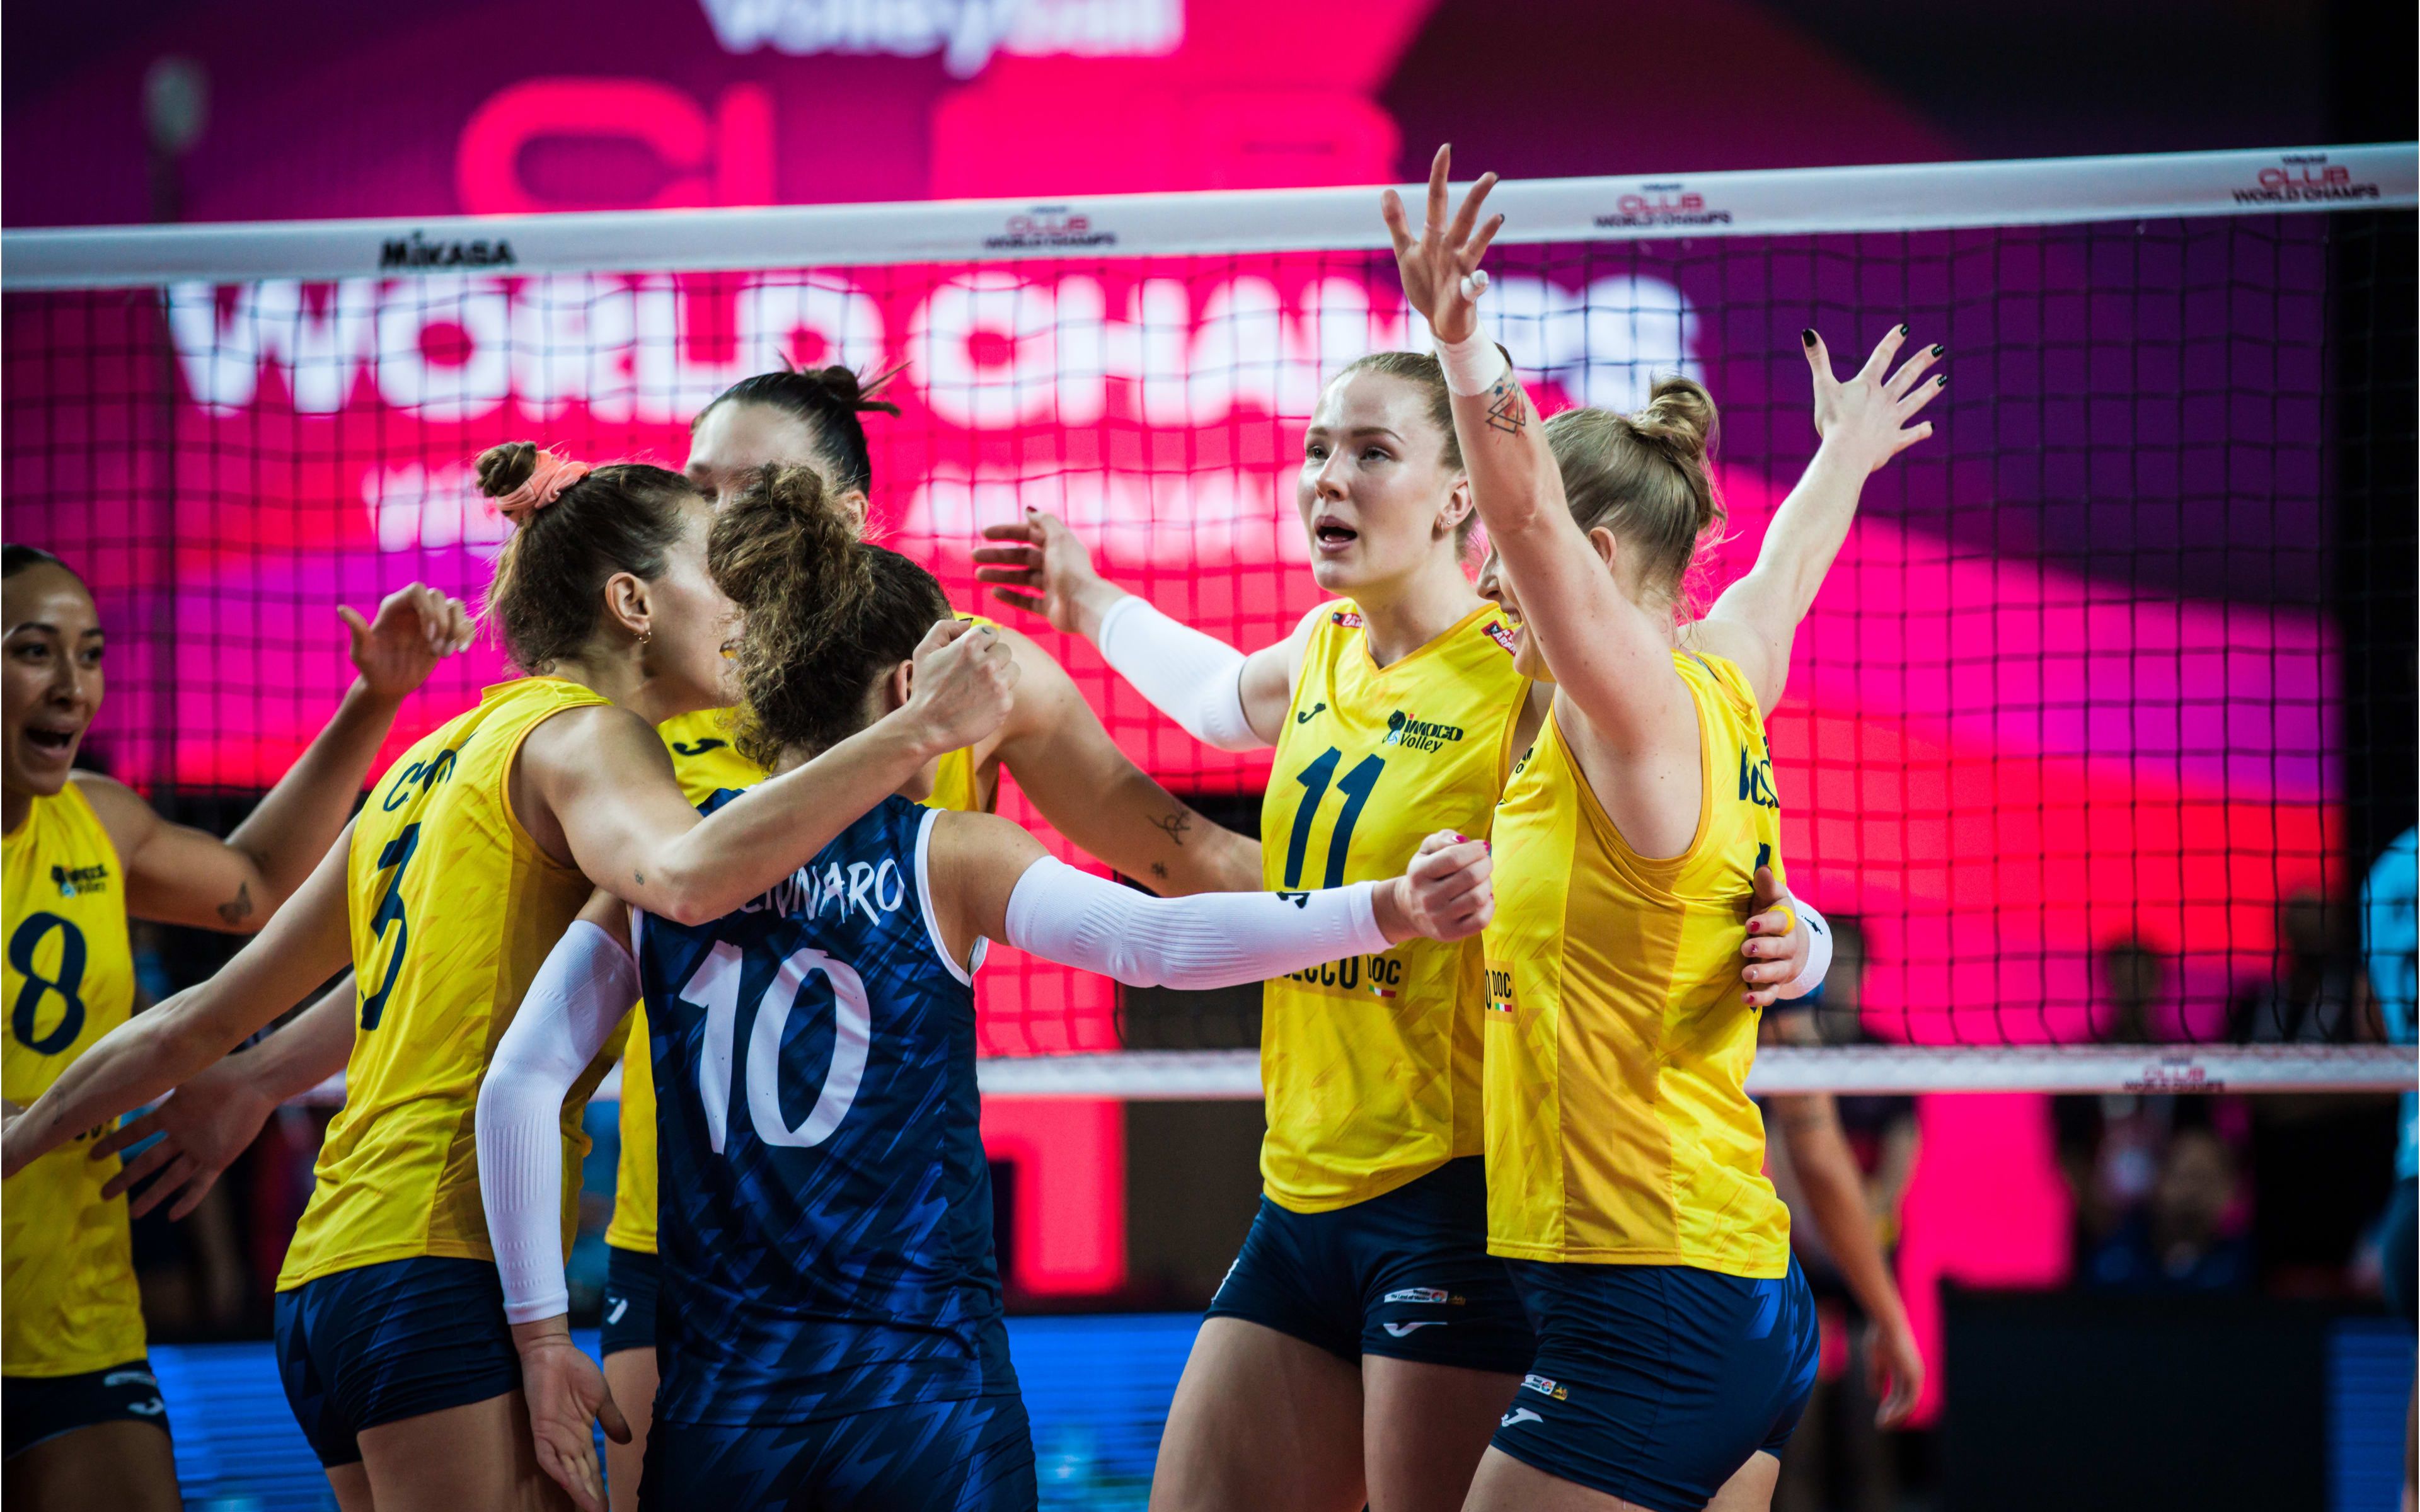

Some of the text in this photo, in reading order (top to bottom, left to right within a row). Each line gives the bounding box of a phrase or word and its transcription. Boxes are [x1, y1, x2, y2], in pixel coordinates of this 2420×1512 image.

[2232, 183, 2380, 203] WORLD CHAMPS
[2257, 166, 2350, 191] CLUB
[163, 275, 885, 425] WORLD
[1400, 733, 1443, 753] Volley
[1284, 746, 1385, 890] 11
[9, 912, 86, 1056] 8
[1492, 970, 1512, 999] DOC
[679, 940, 872, 1155] 10
